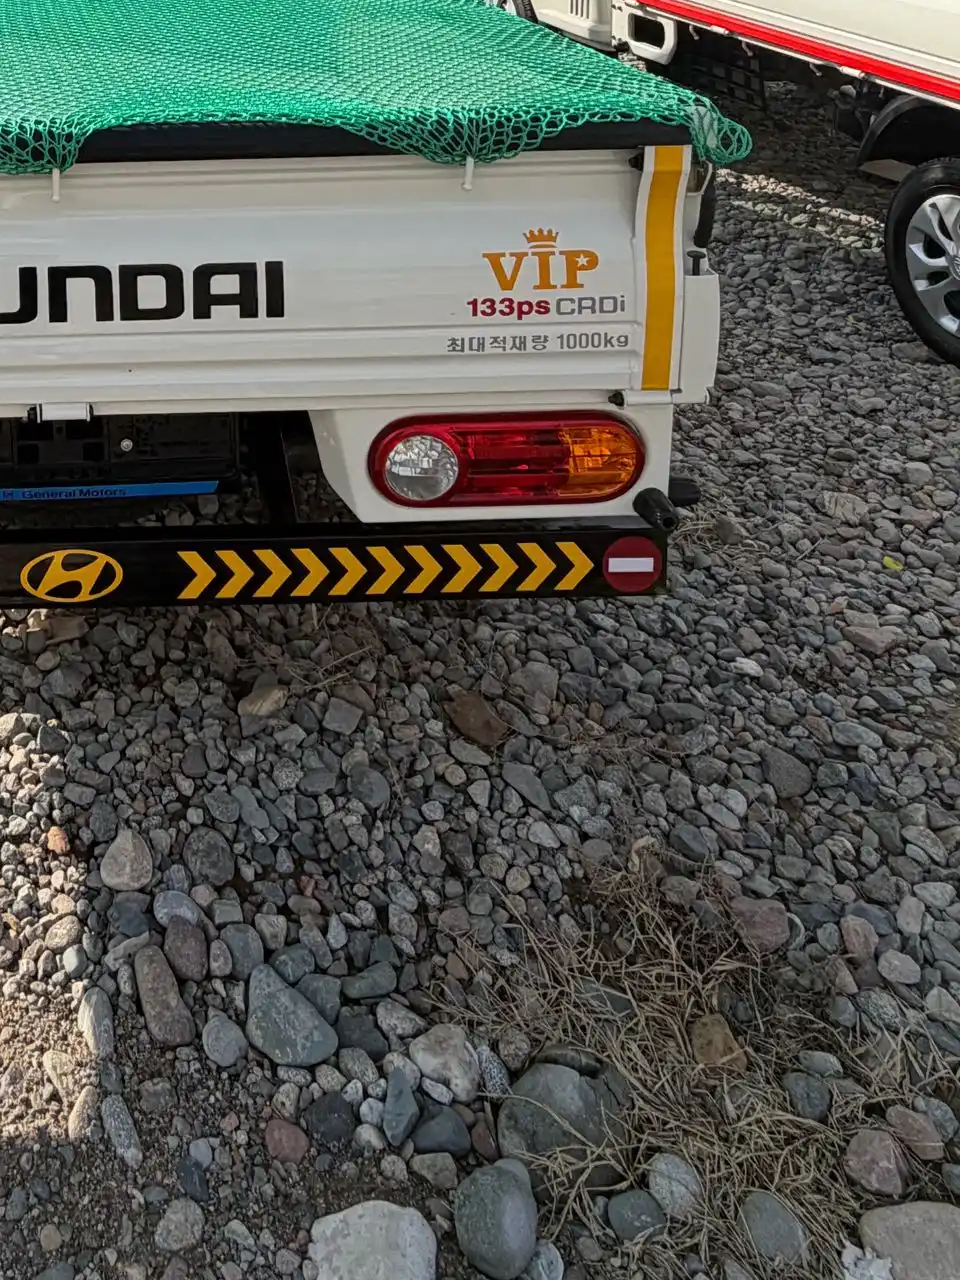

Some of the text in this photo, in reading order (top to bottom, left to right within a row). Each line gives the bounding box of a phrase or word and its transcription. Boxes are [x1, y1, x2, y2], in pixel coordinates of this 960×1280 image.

[482, 249, 599, 292] VIP
[466, 295, 626, 320] 133ps CRDi
[446, 332, 629, 353] 최대적재량 1000kg
